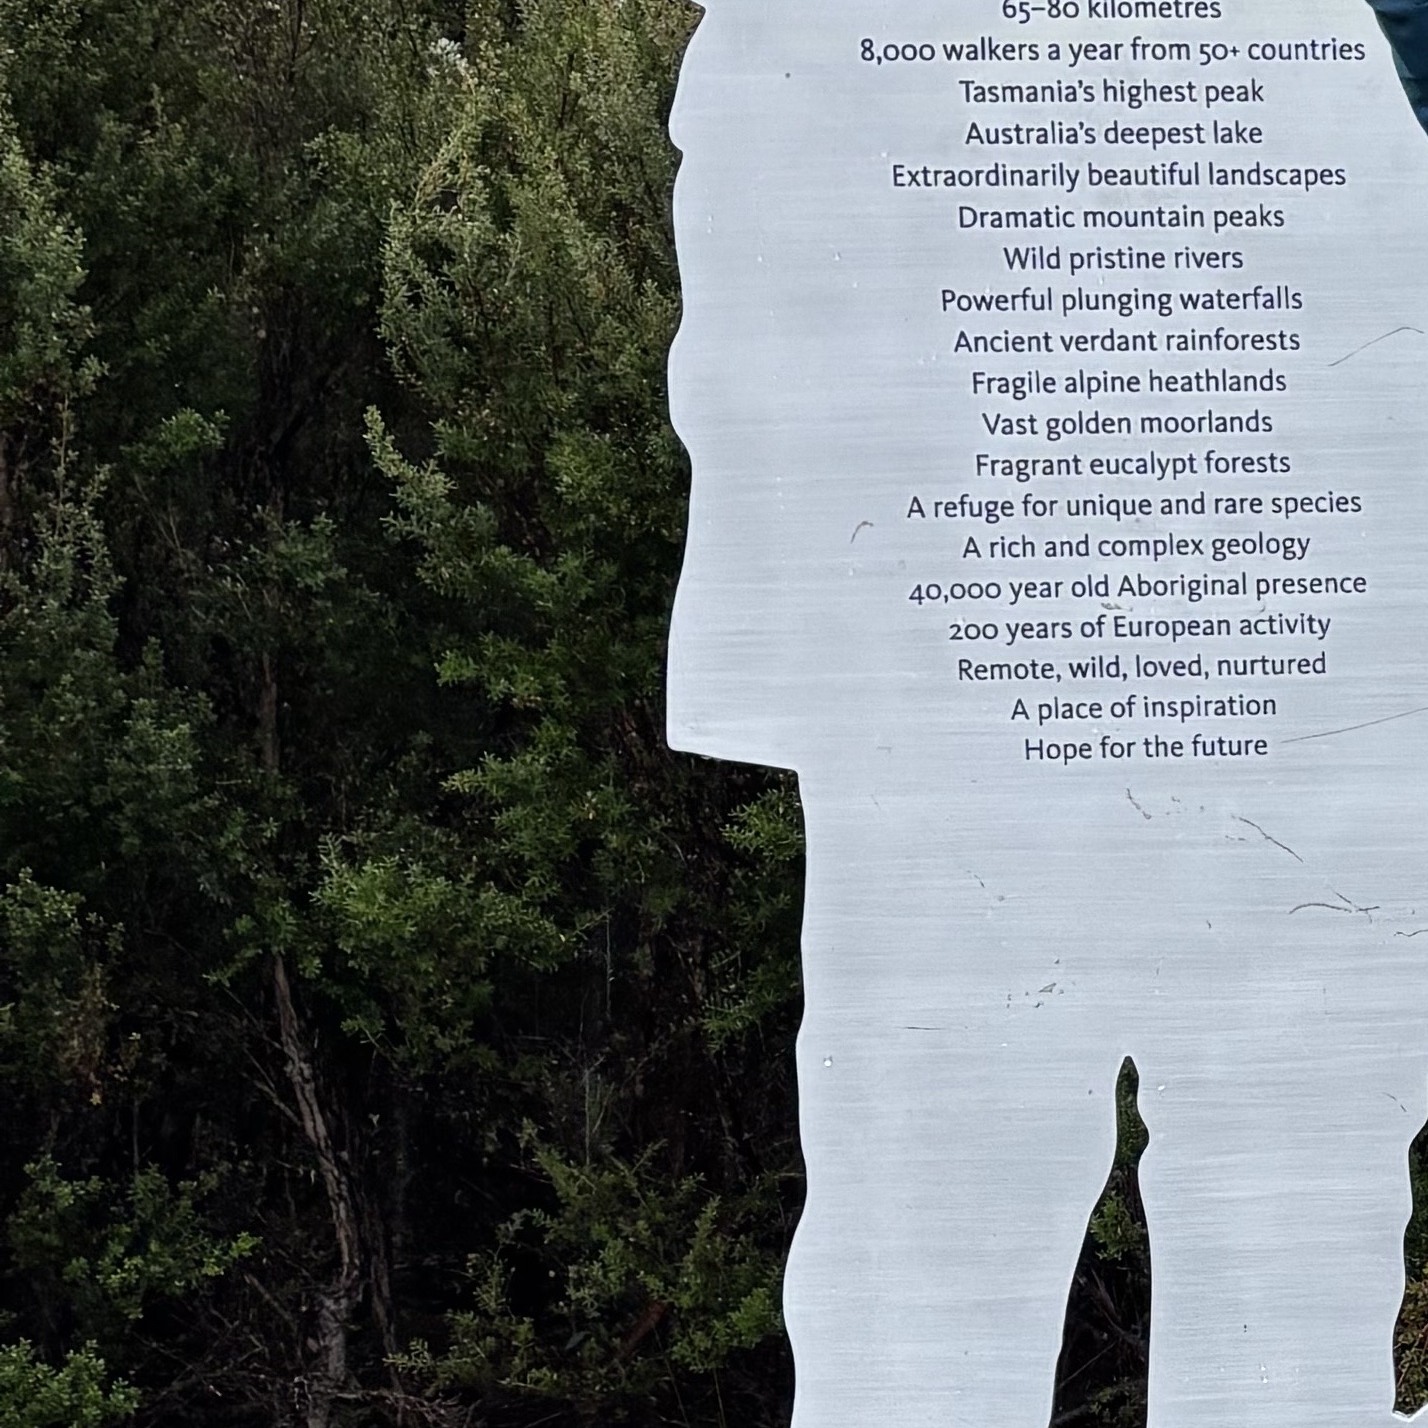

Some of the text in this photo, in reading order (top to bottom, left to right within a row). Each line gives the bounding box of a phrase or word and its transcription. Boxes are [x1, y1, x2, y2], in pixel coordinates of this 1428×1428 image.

[860, 35, 1366, 68] 8,000 walkers a year from 50+ countries
[1103, 78, 1198, 110] highest
[1205, 77, 1265, 109] peak
[1103, 119, 1206, 151] deepest
[1213, 119, 1263, 144] lake
[892, 161, 1347, 193] Extraordinarily beautiful landscapes
[958, 203, 1285, 234] Dramatic mountain peaks
[1002, 245, 1244, 276] Wild pristine rivers
[941, 285, 1303, 318] Powerful plunging waterfalls
[953, 326, 1301, 353] Ancient verdant rainforests
[972, 367, 1287, 401] Fragile alpine heathlands
[981, 408, 1273, 442] Vast golden moorlands
[976, 449, 1291, 483] Fragrant eucalypt forests
[906, 490, 1362, 525] A refuge for unique and rare species
[962, 530, 1311, 562] A rich and complex geology
[908, 571, 1367, 606] 40,000 year old Aboriginal presence
[949, 612, 1331, 646] 200 years of European activity
[958, 650, 1327, 683] Remote, wild, loved, nurtured
[1010, 693, 1277, 727] A place of inspiration
[1025, 733, 1268, 766] Hope for the future
